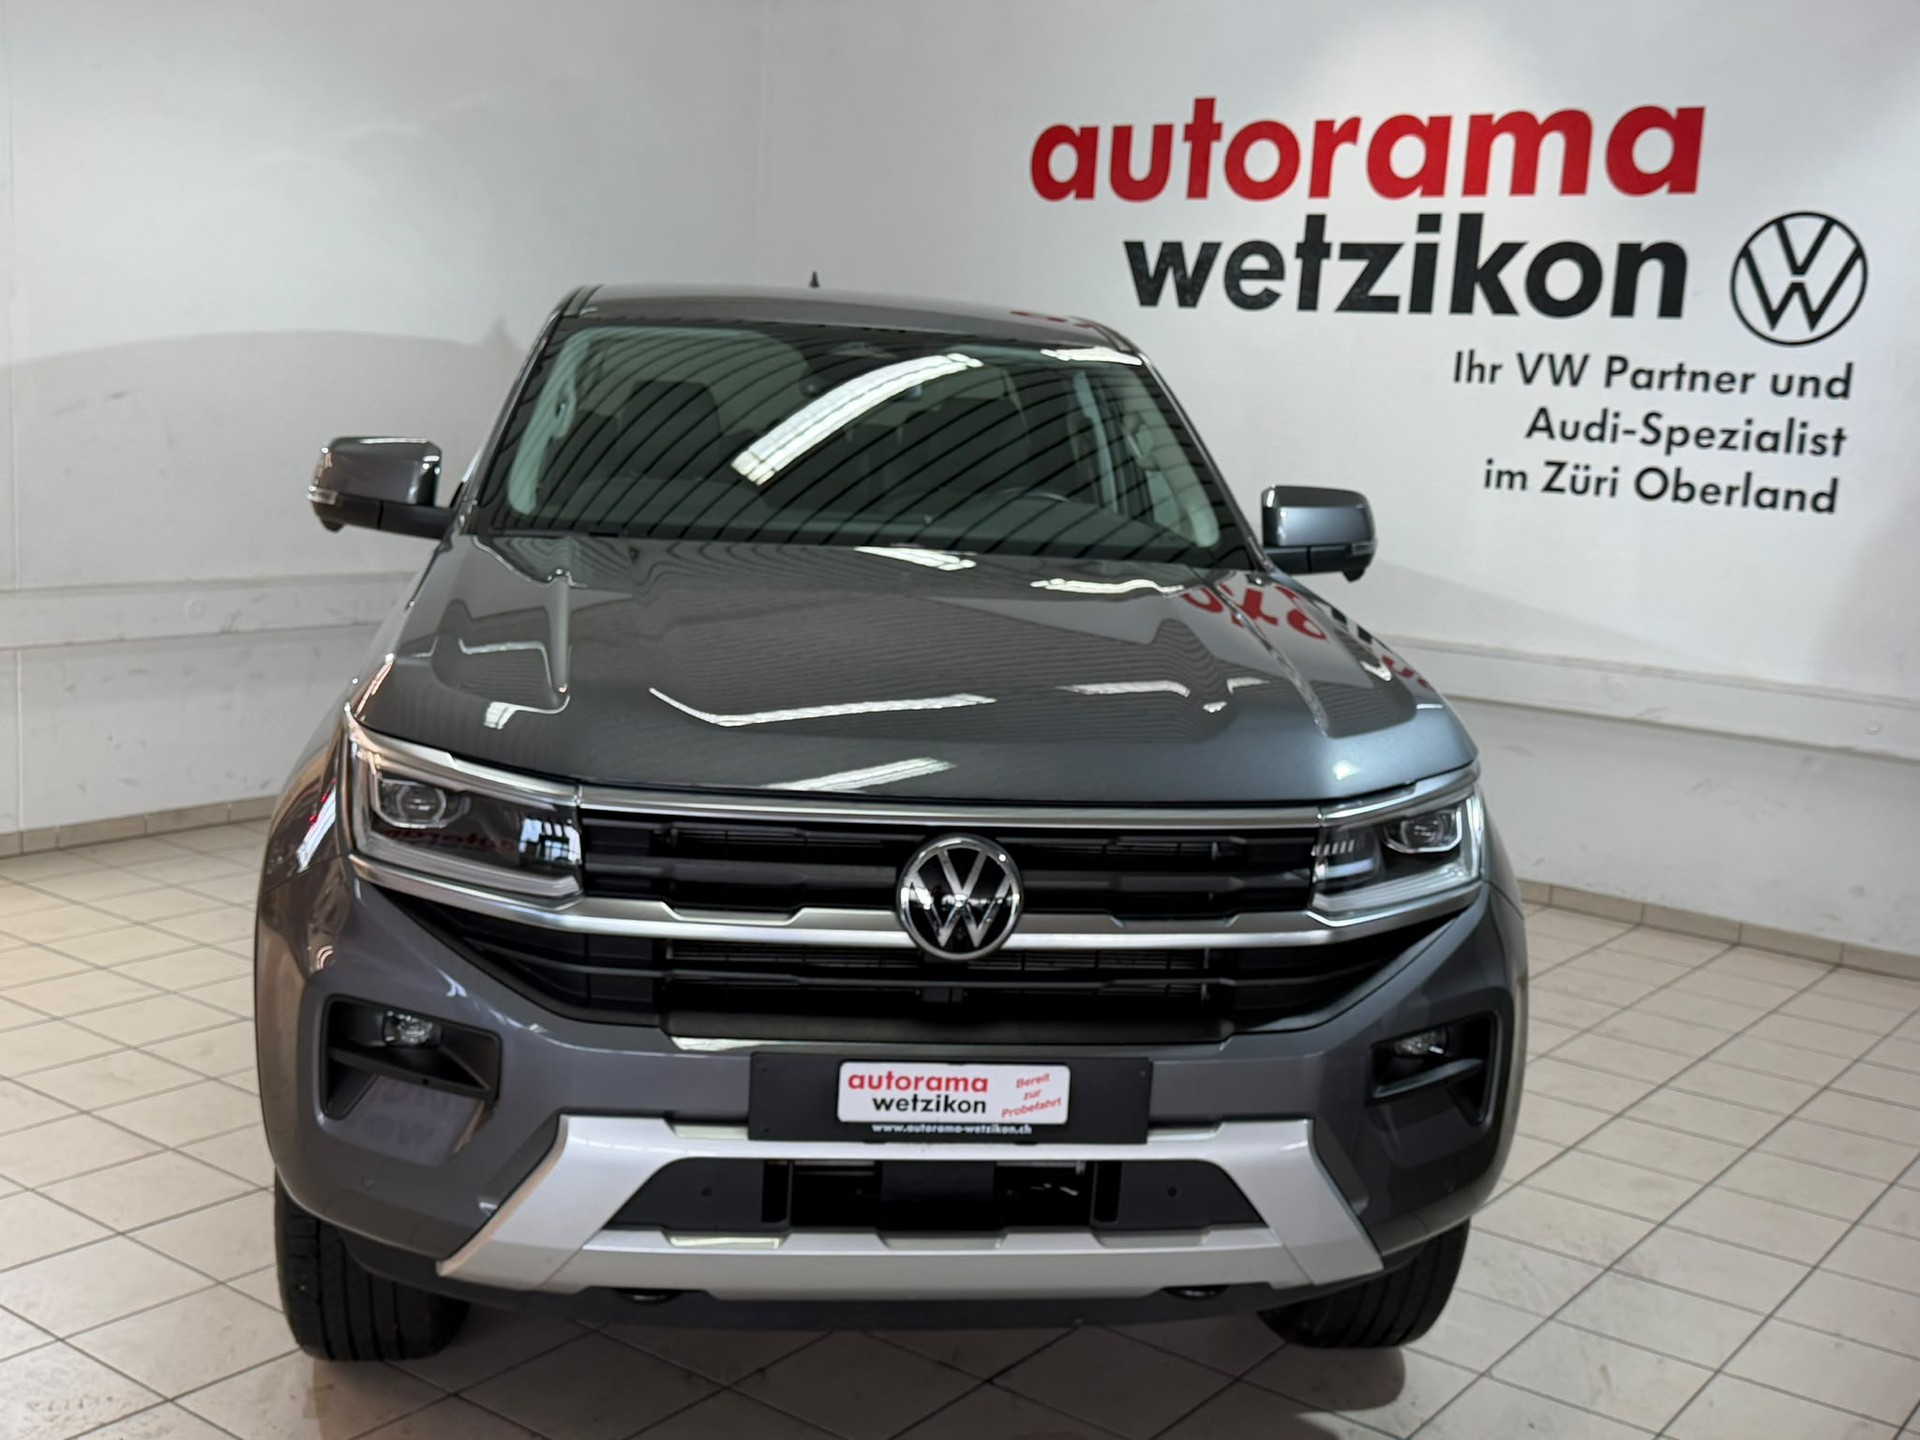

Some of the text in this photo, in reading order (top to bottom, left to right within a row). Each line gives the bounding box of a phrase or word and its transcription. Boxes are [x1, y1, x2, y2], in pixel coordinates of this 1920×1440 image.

[1030, 97, 1705, 202] autorama
[1123, 212, 1689, 319] wetzikon
[1731, 211, 1868, 346] VW
[1453, 349, 1853, 399] Ihr VW Partner und
[1525, 406, 1848, 458] Audi-Spezialist
[1484, 458, 1839, 514] im Züri Oberland
[847, 1070, 989, 1093] autorama
[871, 1093, 987, 1114] wetzikon
[1014, 1072, 1051, 1089] Bereit
[1022, 1088, 1042, 1101] zur
[1001, 1096, 1062, 1119] Probefahrt
